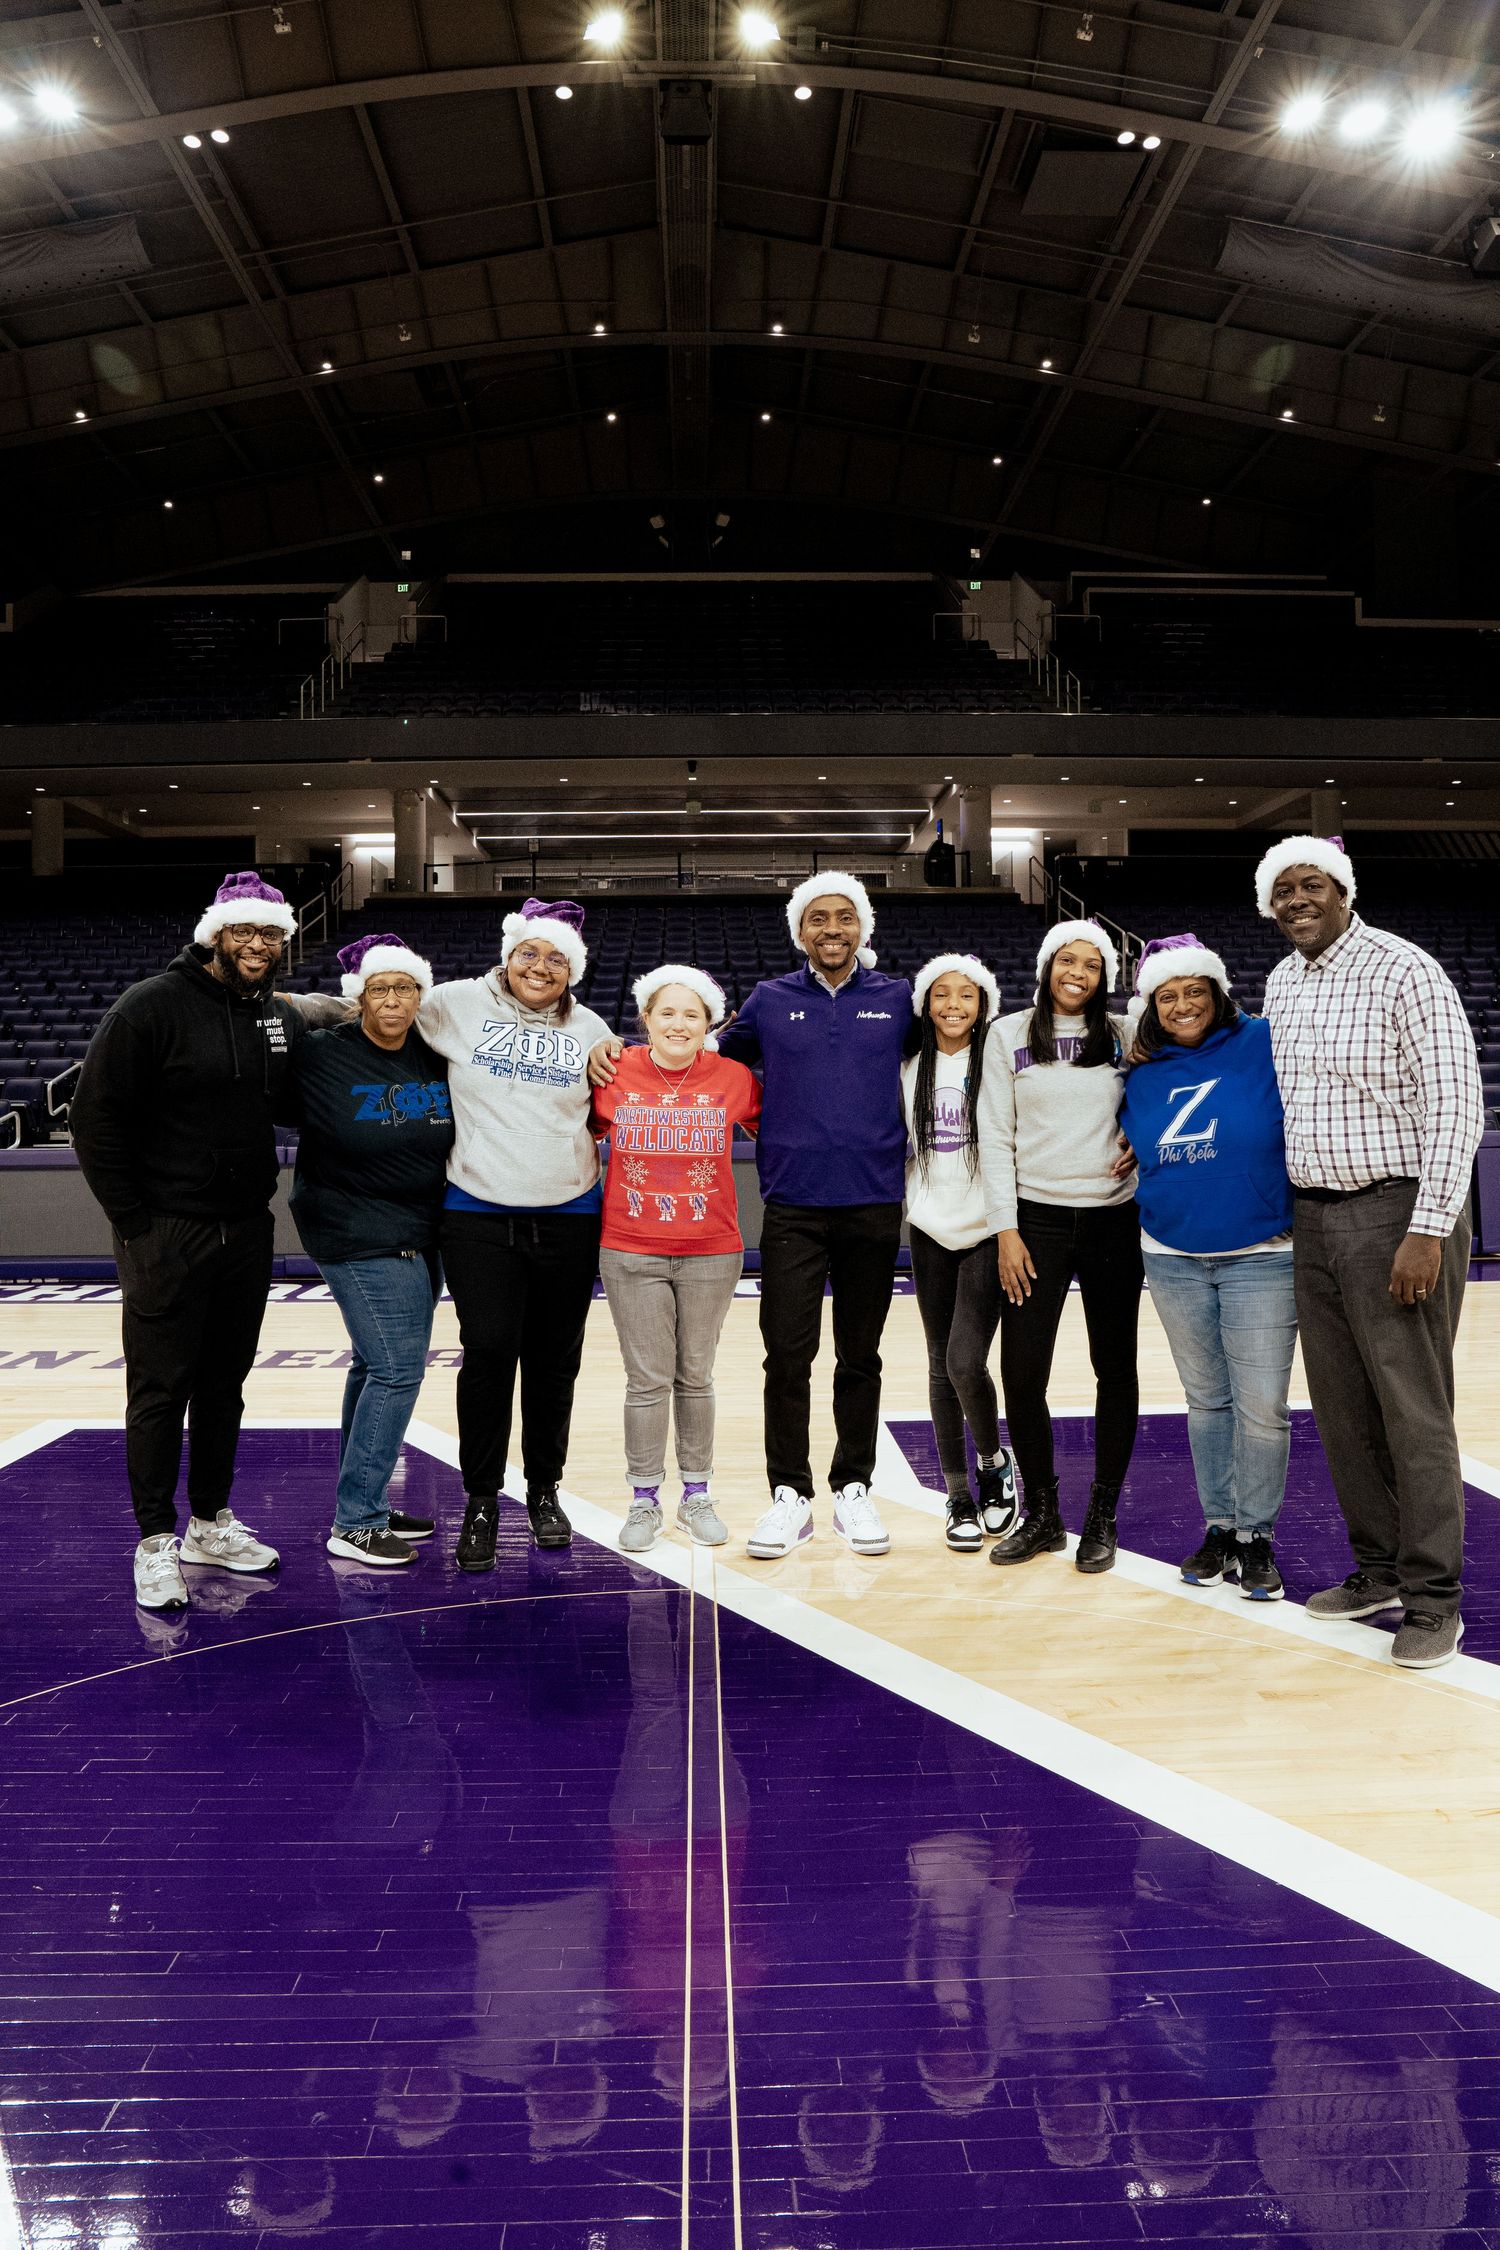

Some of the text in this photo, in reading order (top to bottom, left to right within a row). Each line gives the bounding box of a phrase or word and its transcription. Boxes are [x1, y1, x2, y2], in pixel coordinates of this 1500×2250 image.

[266, 1026, 285, 1036] must
[269, 1035, 287, 1045] stop.
[472, 1055, 581, 1083] Scholarship Service Sisterhood
[614, 1107, 726, 1126] NORTHWESTERN
[1155, 1077, 1222, 1149] Z
[615, 1126, 725, 1153] WILDCATS
[1158, 1142, 1218, 1164] Phi Beta
[660, 1196, 672, 1212] N
[694, 1194, 704, 1210] N
[210, 1540, 227, 1553] N
